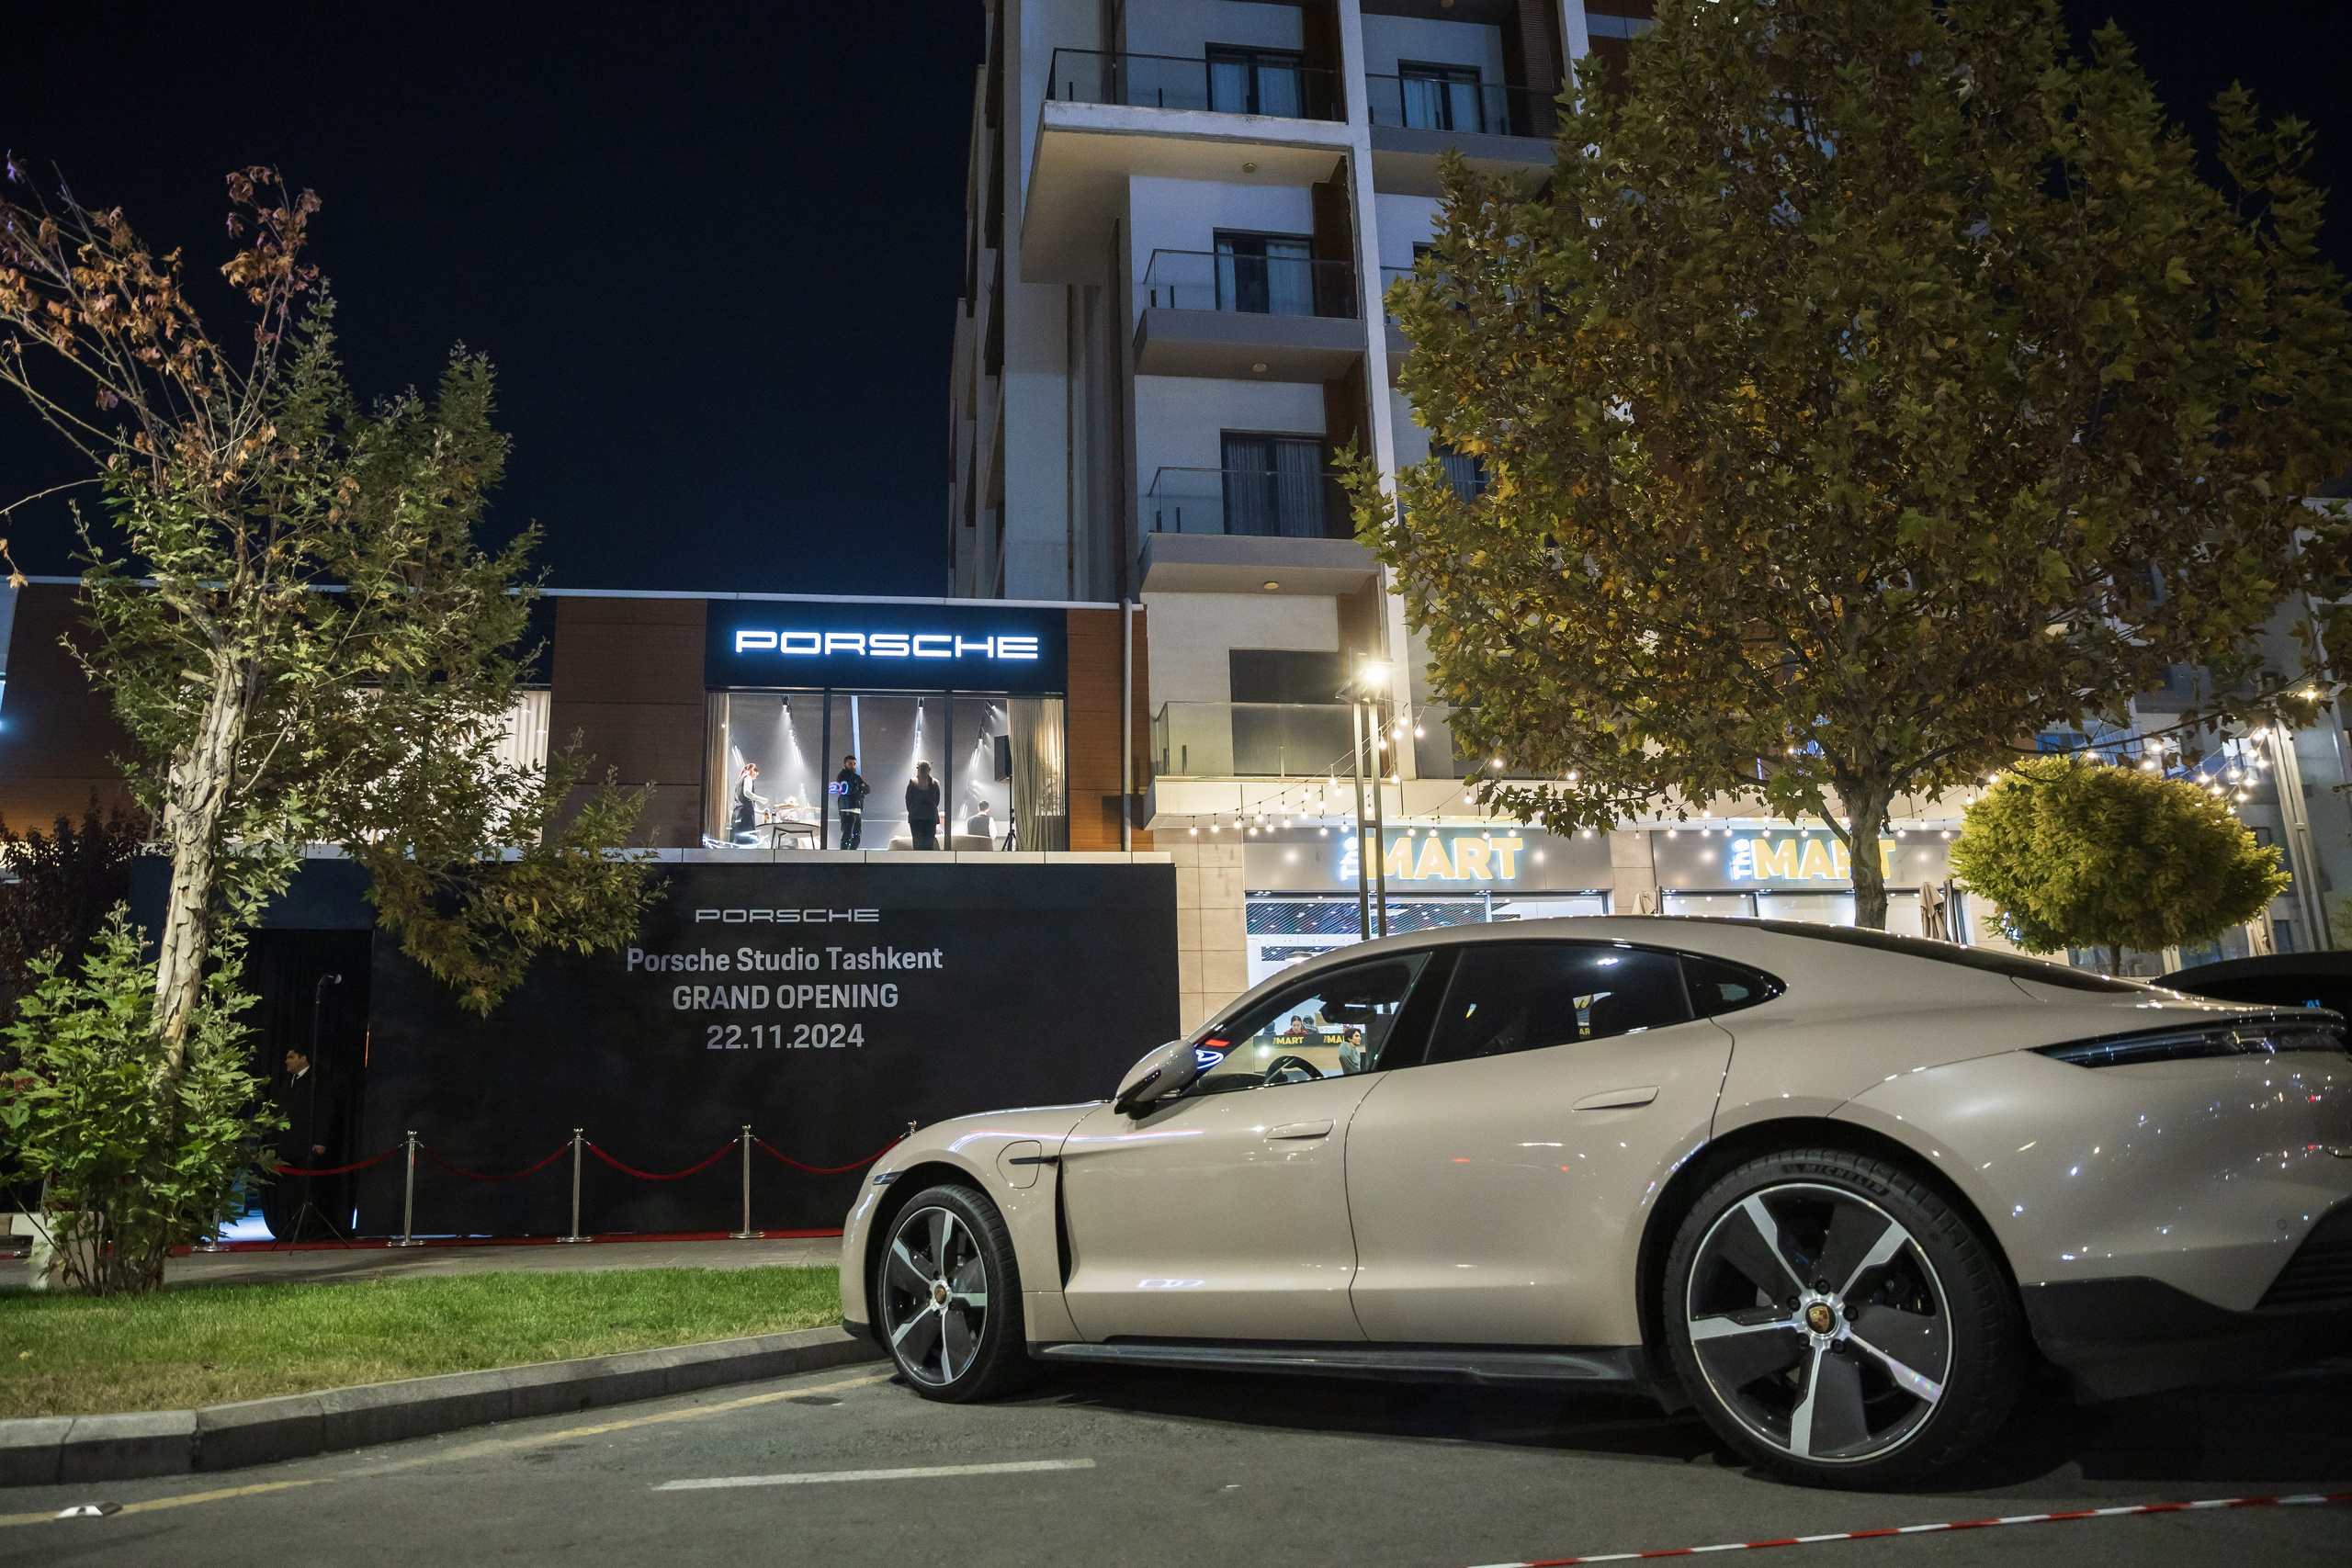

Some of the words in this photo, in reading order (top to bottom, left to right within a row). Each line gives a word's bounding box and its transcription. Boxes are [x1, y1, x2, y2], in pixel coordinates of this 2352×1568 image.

[735, 630, 1039, 660] PORSCHE
[1364, 837, 1524, 880] MART
[1731, 838, 1752, 881] The
[695, 908, 880, 923] PORSCHE
[628, 947, 730, 972] Porsche
[736, 947, 820, 972] Studio
[825, 946, 944, 970] Tashkent
[673, 985, 770, 1010] GRAND
[776, 983, 899, 1010] OPENING
[707, 1023, 865, 1050] 22.11.2024
[1276, 1036, 1304, 1044] MART
